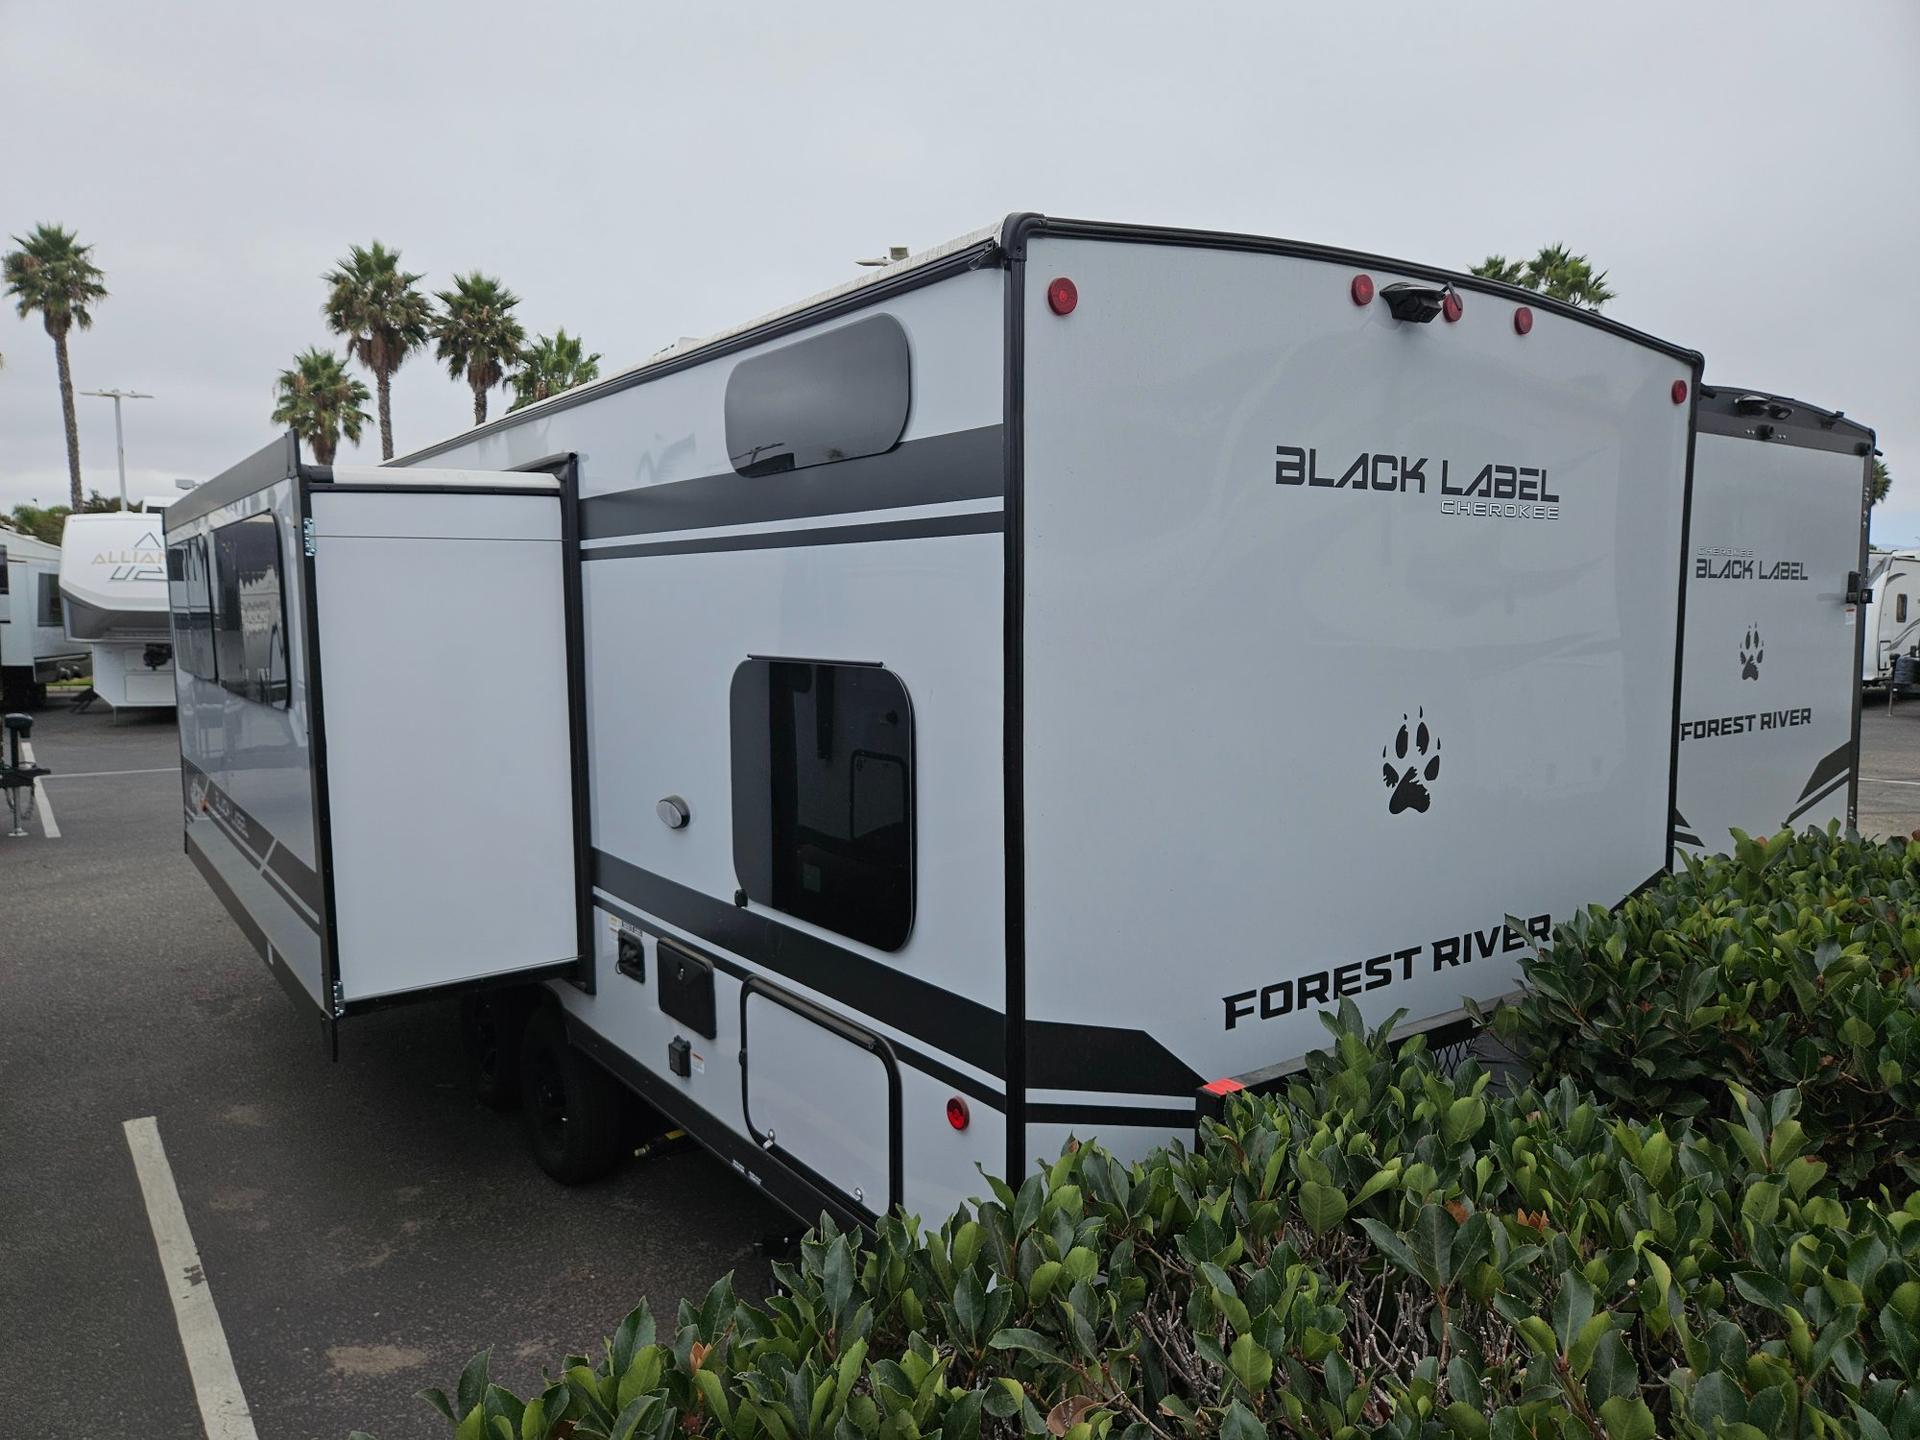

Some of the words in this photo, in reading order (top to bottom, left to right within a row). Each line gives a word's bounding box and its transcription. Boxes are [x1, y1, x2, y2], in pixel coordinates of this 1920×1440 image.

[1275, 445, 1429, 494] BLACK
[1440, 459, 1560, 503] LABEL
[1440, 500, 1560, 521] CHEROKEE
[1695, 558, 1754, 579] BLACK
[1758, 560, 1809, 581] LABEL
[1680, 713, 1756, 741] FOREST
[1760, 707, 1812, 731] RIVER
[1221, 945, 1423, 1031] FOREST
[1431, 913, 1552, 972] RIVER
